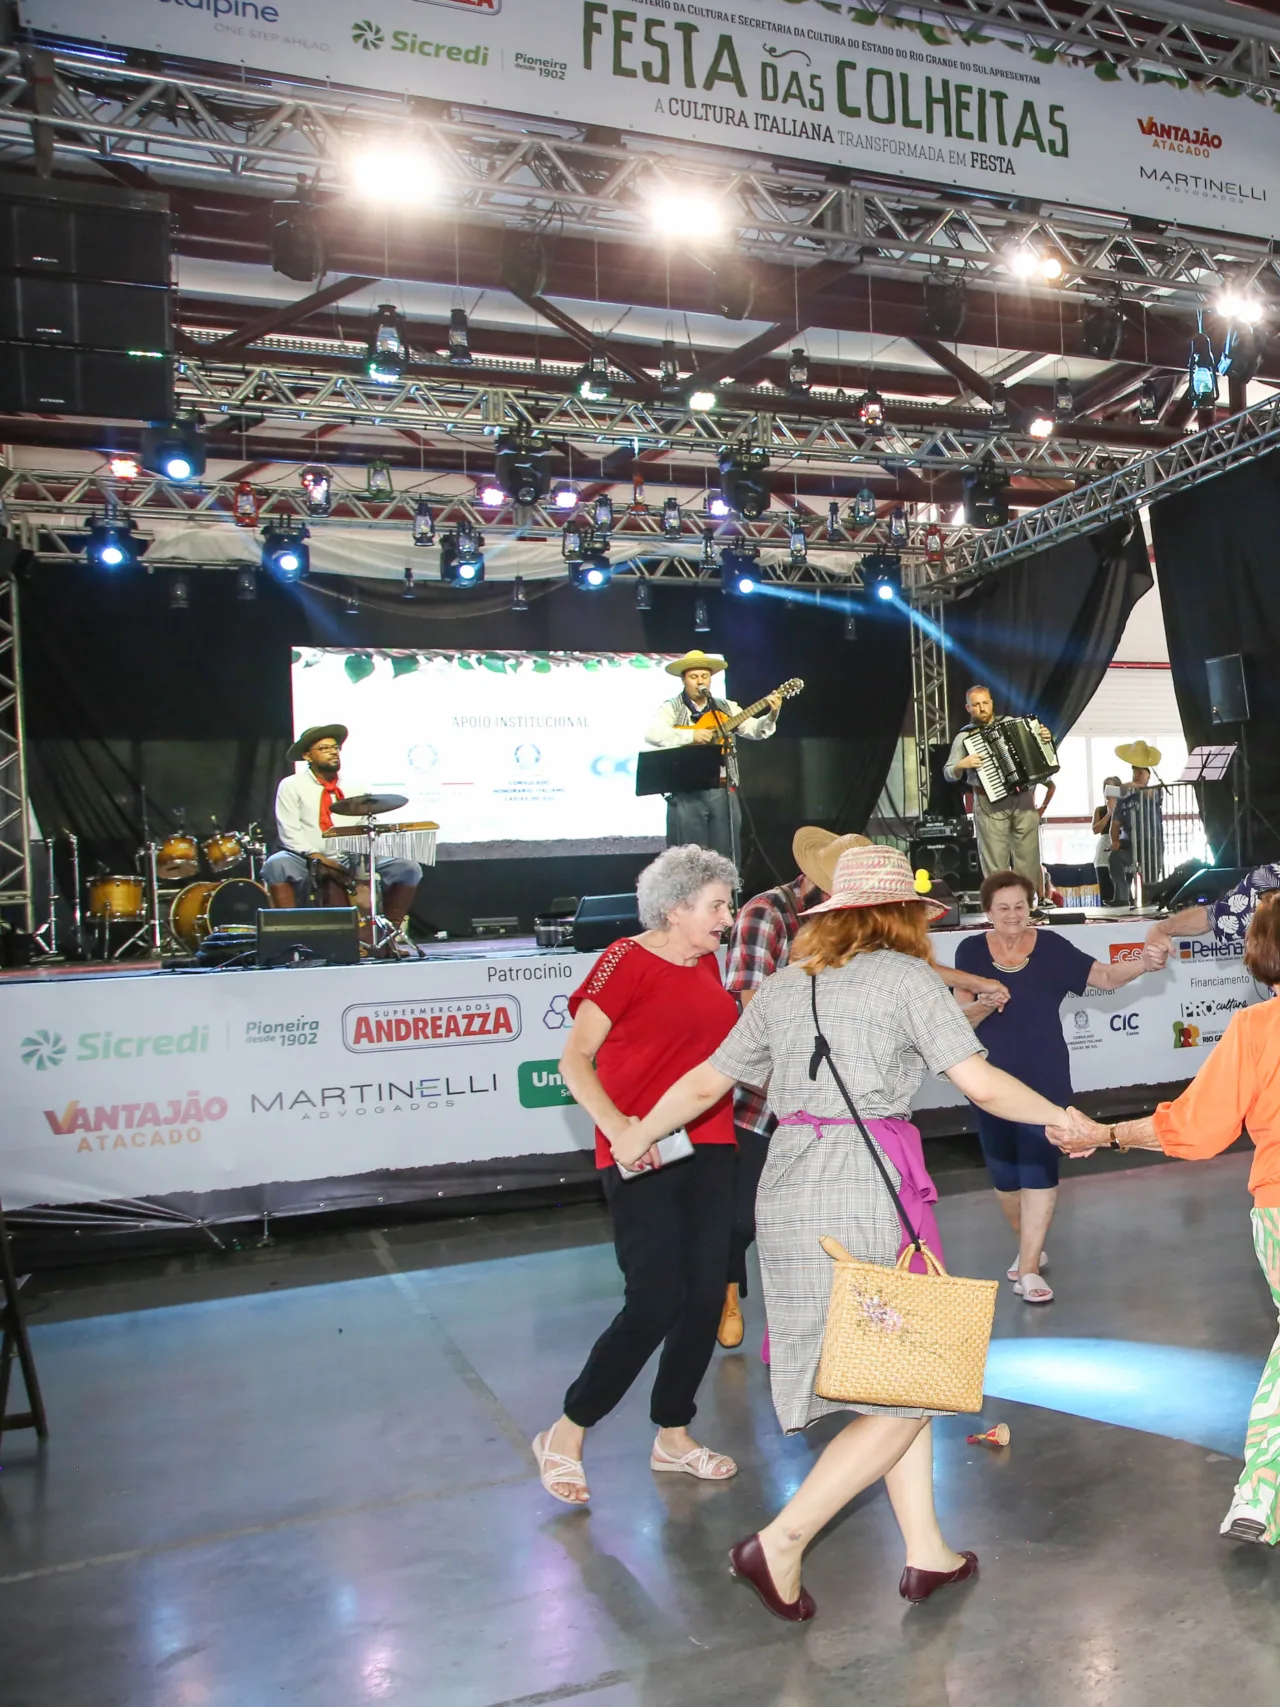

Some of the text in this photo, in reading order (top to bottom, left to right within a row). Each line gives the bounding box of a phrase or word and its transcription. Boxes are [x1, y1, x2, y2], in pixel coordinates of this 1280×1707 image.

[214, 23, 245, 36] ONE
[248, 29, 279, 41] STEP
[391, 30, 489, 66] Sicredi
[674, 3, 686, 13] DA
[687, 4, 729, 22] CULTURA
[731, 14, 736, 23] E
[738, 15, 792, 36] SECRETARIA
[794, 28, 806, 38] DA
[807, 29, 846, 47] CULTURA
[848, 38, 859, 49] DO
[861, 40, 894, 56] ESTADO
[896, 48, 908, 58] DO
[909, 50, 924, 62] RIO
[925, 54, 958, 69] GRANDE
[960, 61, 971, 71] DO
[972, 63, 988, 75] SUL
[989, 66, 1041, 85] APRESENTAM
[515, 52, 567, 70] Pioneira
[538, 67, 565, 80] 1902
[583, 0, 1069, 158] FESTA DAS COLHEITAS
[654, 97, 1016, 175] A CULTURA ITALIANA TRANSFORMADA EM FESTA
[1137, 116, 1223, 149] VANTAJÃO
[1152, 138, 1210, 158] ATACADO
[1140, 165, 1266, 202] MARTINELLI
[1166, 185, 1244, 204] ADVOGADOS
[452, 715, 590, 729] APOIO INSTITUCIONAL
[487, 962, 572, 982] Patrocínio
[1190, 975, 1250, 988] Financiamento
[374, 1003, 491, 1018] SUPERMERCADOS
[1216, 998, 1248, 1013] cultura
[245, 1015, 319, 1035] Pioneira
[352, 1006, 514, 1045] ANDREAZZA
[1110, 1012, 1139, 1032] CIC
[76, 1024, 210, 1061] Sicredi
[245, 1032, 318, 1047] desde 1902
[1203, 1035, 1213, 1043] RIO
[250, 1073, 497, 1113] MARTINELLI
[43, 1090, 228, 1136] VANTAJÃO
[302, 1100, 455, 1121] ADVOGADOS
[77, 1127, 202, 1154] ATACADO
